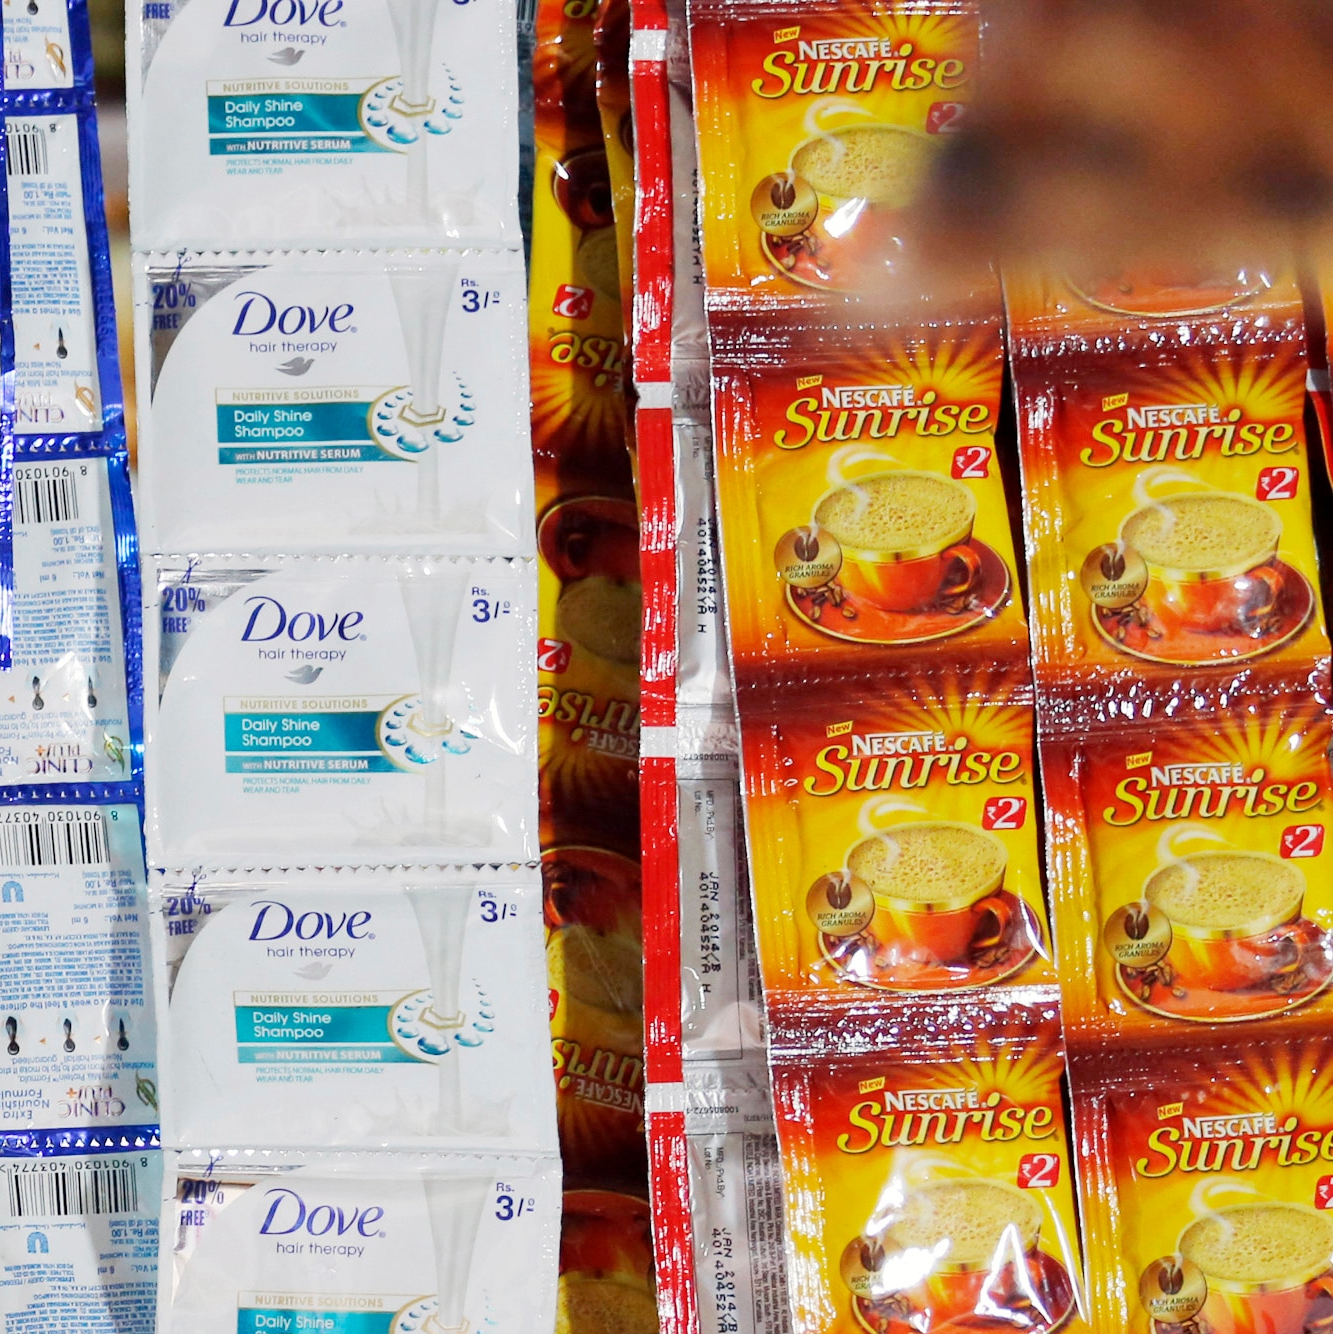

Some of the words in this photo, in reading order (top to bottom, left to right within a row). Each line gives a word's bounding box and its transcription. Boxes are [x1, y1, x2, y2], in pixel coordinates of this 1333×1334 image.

[752, 44, 965, 98] Sunrise
[152, 283, 195, 308] 20%
[232, 292, 354, 336] Dove
[250, 341, 277, 352] hair
[282, 340, 337, 353] therapy
[233, 391, 290, 400] NUTRITIVE
[295, 390, 359, 400] SOLUTIONS
[235, 410, 269, 424] Daily
[273, 409, 312, 422] Shine
[235, 425, 304, 439] Shampoo
[774, 391, 993, 449] Sunrise
[1081, 411, 1296, 468] Sunrise
[241, 596, 363, 642] Dove
[804, 737, 1022, 797] Sunrise
[1103, 769, 1320, 826] Sunrise
[249, 901, 372, 941] Dove
[838, 1093, 1055, 1155] Sunrise
[259, 1188, 384, 1236] Dove
